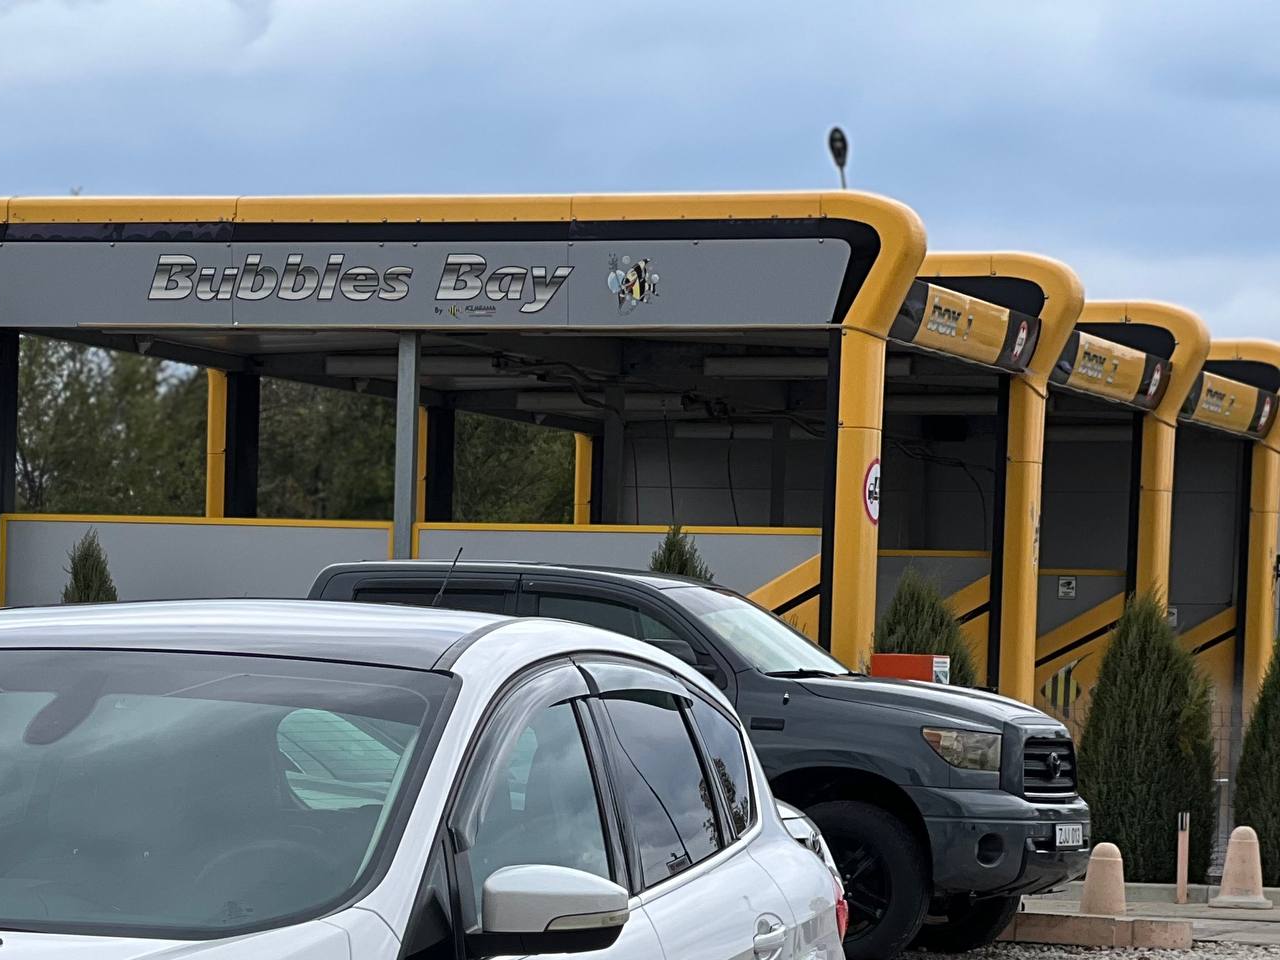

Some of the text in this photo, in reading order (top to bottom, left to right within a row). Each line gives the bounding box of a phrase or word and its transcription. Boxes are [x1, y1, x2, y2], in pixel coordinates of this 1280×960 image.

[147, 252, 575, 314] Bubbles Bay
[434, 306, 443, 316] By
